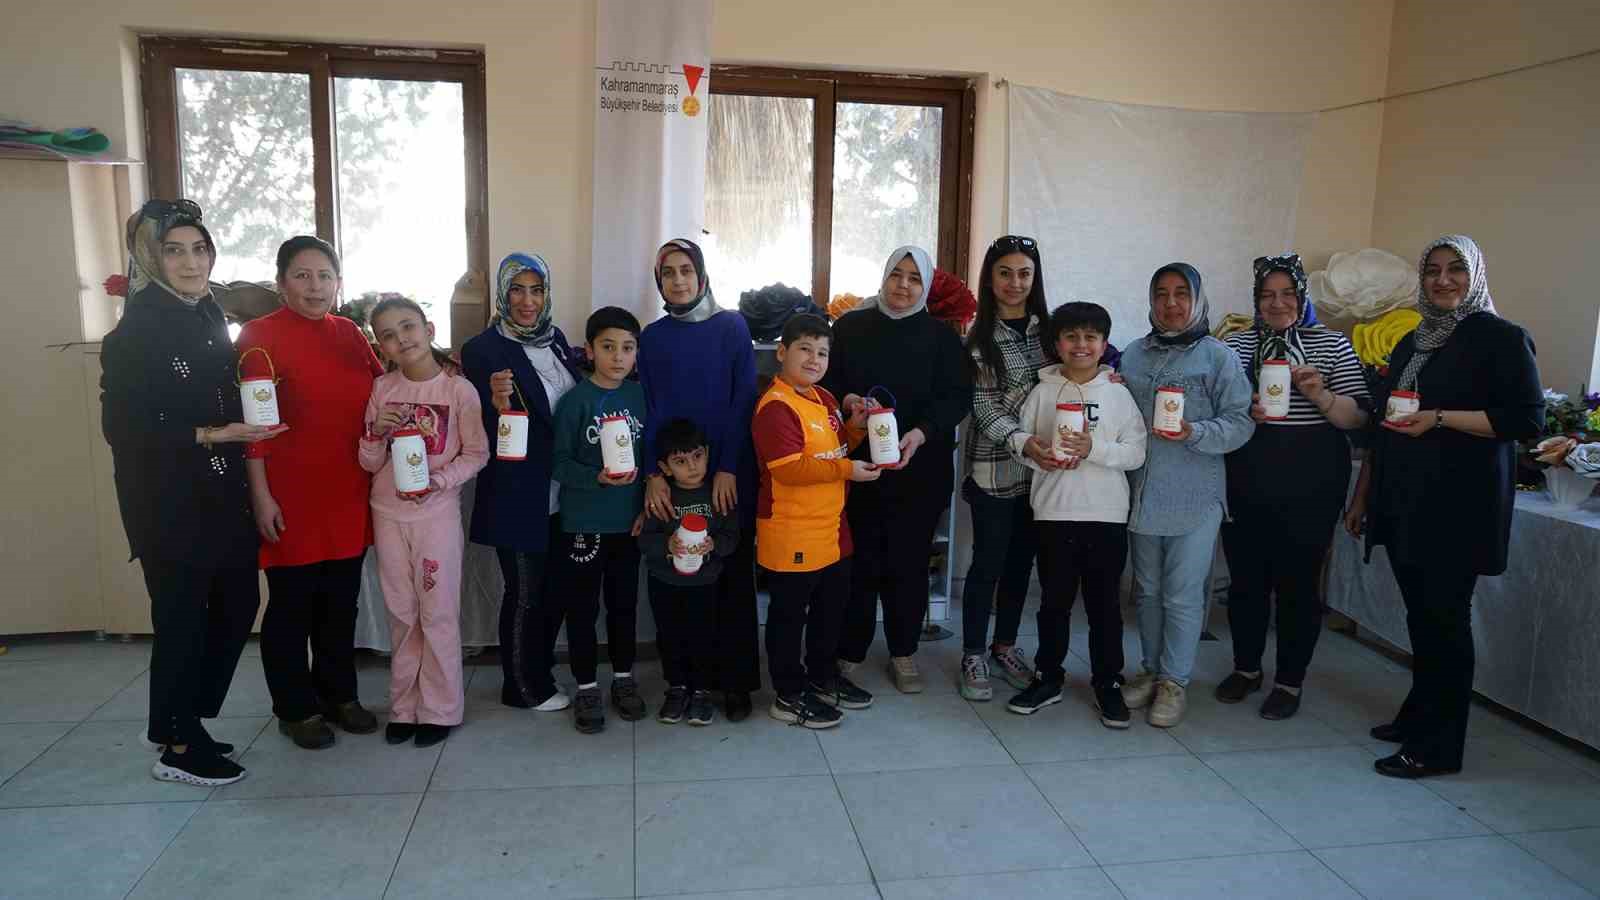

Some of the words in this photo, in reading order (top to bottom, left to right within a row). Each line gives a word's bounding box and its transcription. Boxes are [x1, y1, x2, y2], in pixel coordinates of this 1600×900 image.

[601, 77, 678, 98] Kahramanmaraş
[601, 97, 640, 112] Büyükşehir
[642, 99, 678, 115] Belediyesi
